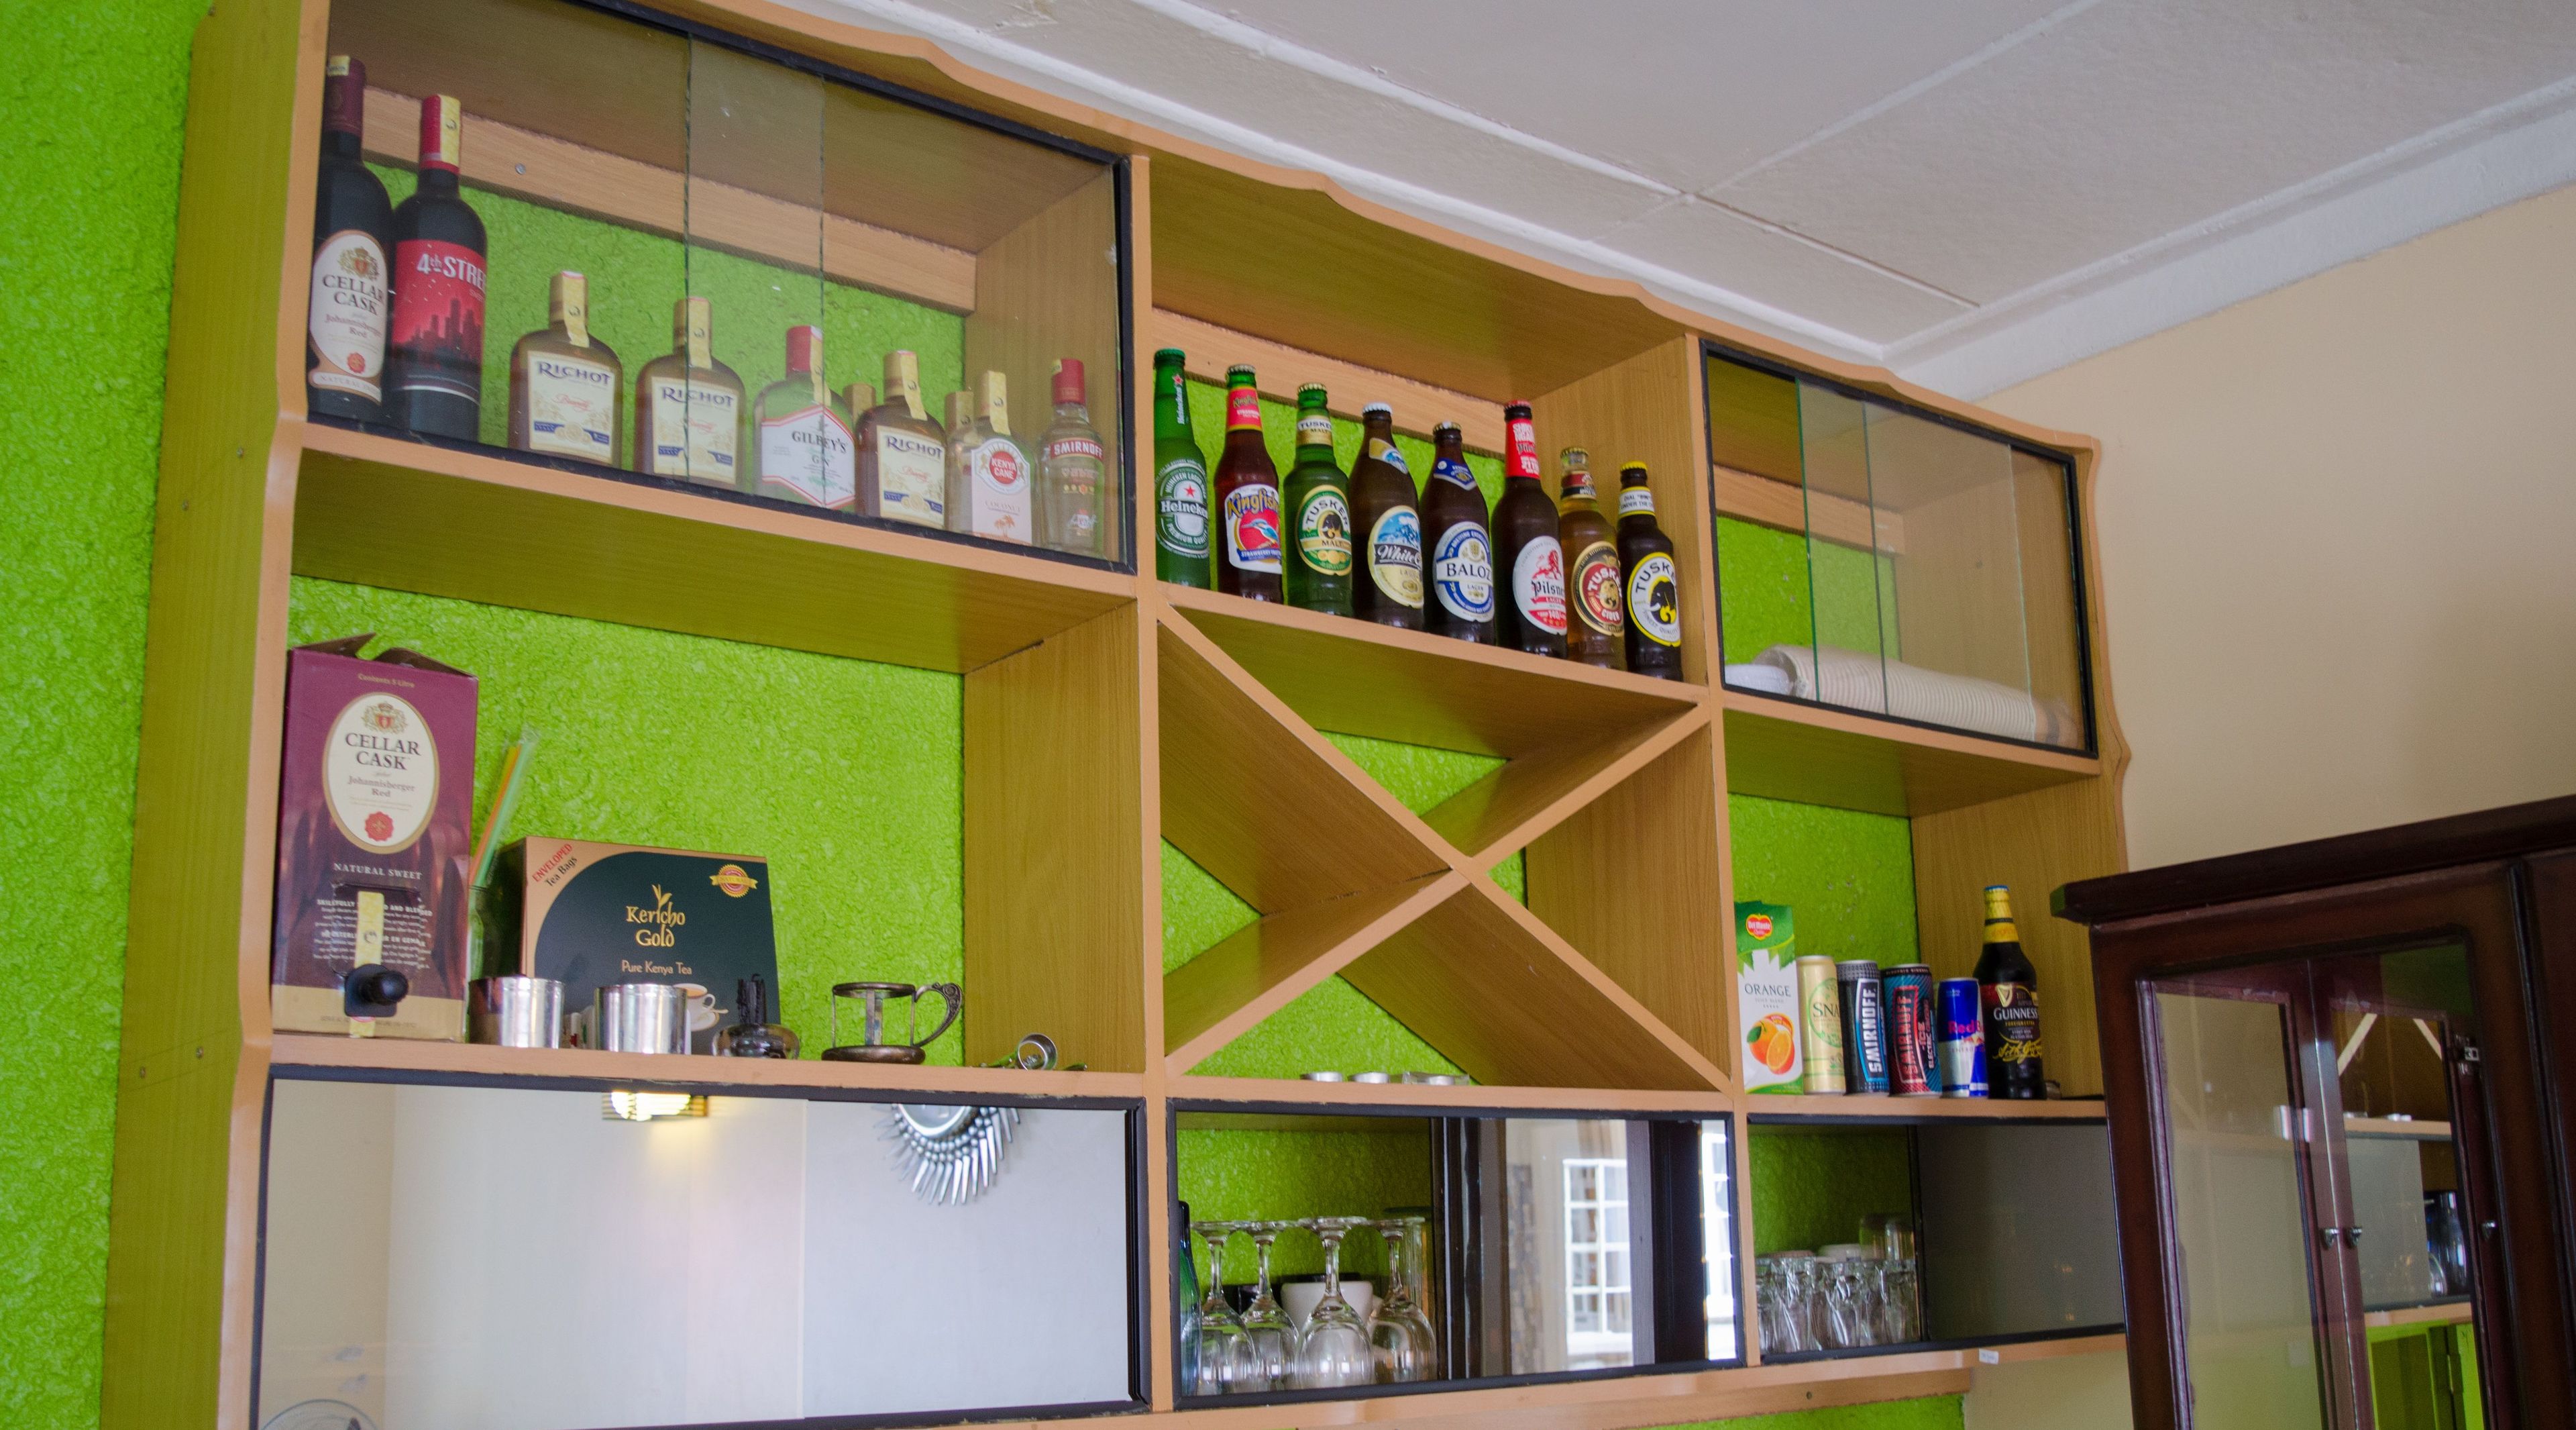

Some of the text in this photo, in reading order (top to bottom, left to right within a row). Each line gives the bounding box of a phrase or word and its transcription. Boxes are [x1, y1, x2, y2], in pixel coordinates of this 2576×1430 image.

[417, 253, 442, 274] 4th
[334, 291, 378, 315] CASK
[537, 361, 610, 386] RICHOT
[660, 386, 735, 407] RICHOT
[884, 435, 943, 458] RICHOT
[1053, 441, 1104, 459] SMIRNOFF
[1305, 499, 1348, 525] TUSKER
[1322, 539, 1343, 548] MALT
[345, 732, 421, 756] CELLAR
[356, 750, 407, 770] CASK
[333, 863, 423, 880] NATURAL SWEET
[532, 843, 573, 882] ENVELOPED
[545, 856, 578, 887] Tea Bags
[626, 901, 686, 927] Kericho
[635, 923, 676, 947] Gold
[621, 960, 693, 976] Pure Kenya Tea
[1744, 982, 1792, 999] ORANGE
[1993, 1007, 2039, 1021] GUINNESS
[1862, 988, 1883, 1074] SMIRNOFF
[1896, 995, 1919, 1074] SMIRNOFF
[1947, 1019, 1976, 1034] Red
